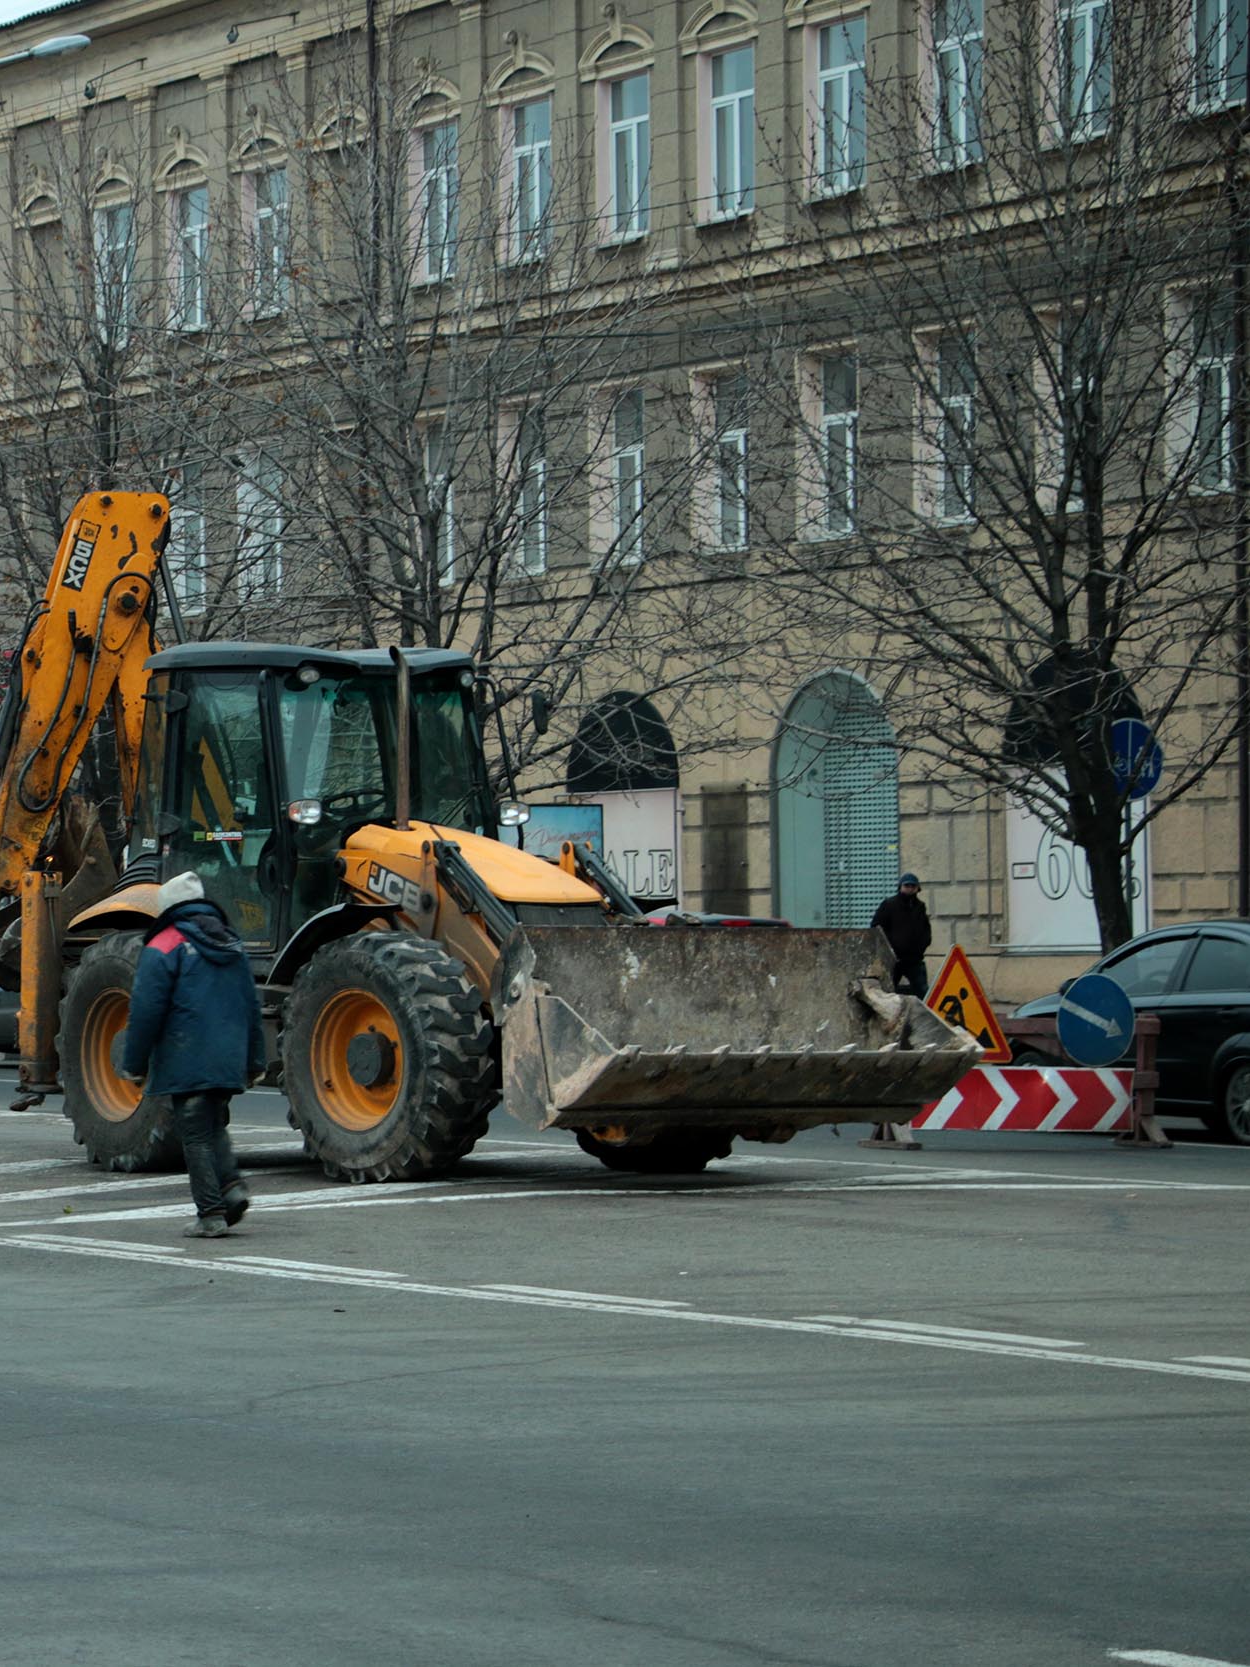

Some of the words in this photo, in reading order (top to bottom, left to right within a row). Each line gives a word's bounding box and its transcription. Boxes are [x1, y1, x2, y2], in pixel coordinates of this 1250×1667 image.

[63, 540, 94, 588] 5CX
[368, 868, 421, 912] JCB
[604, 848, 675, 898] ALE
